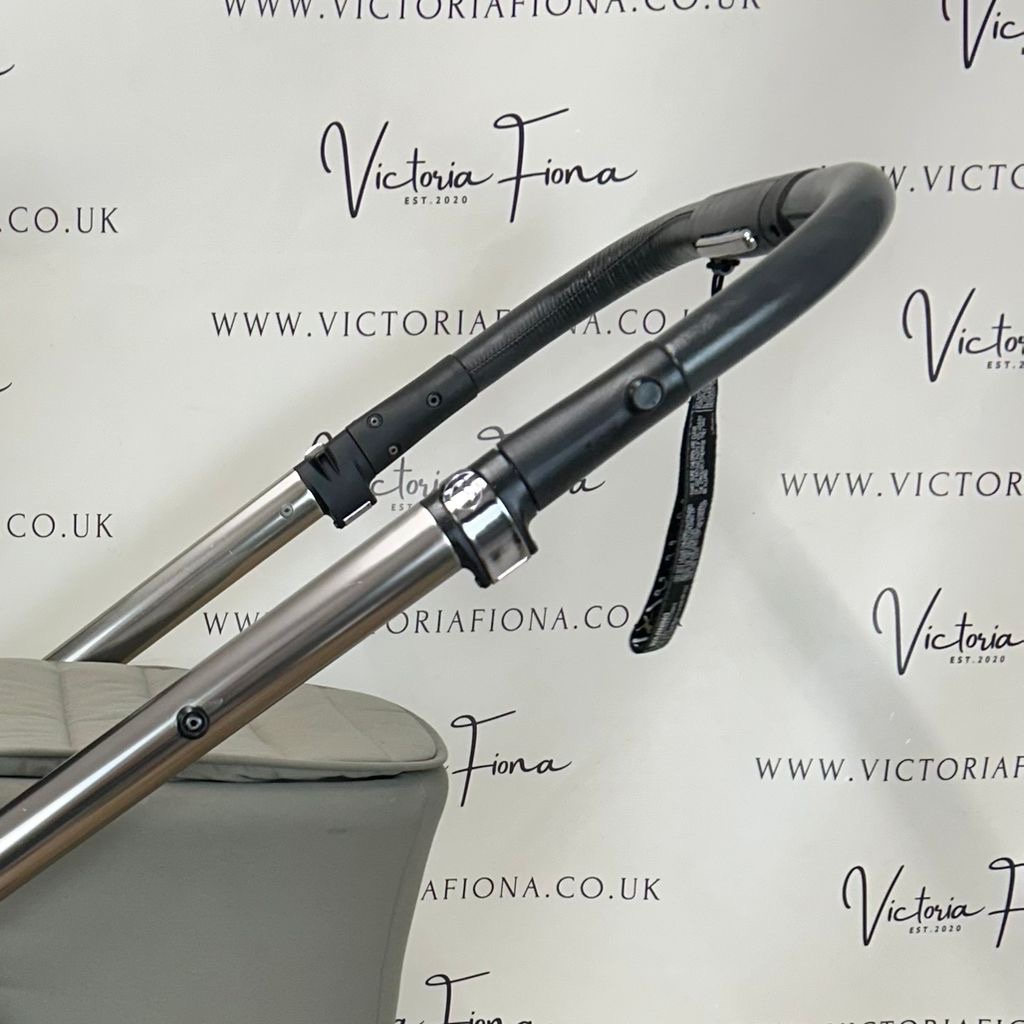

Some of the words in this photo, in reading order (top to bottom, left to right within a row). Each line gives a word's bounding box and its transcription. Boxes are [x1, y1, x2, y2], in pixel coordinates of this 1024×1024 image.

[319, 120, 495, 219] Victoria
[492, 107, 639, 224] Fiona
[404, 195, 468, 206] EST.2020
[872, 586, 1024, 676] Victoria
[949, 655, 1006, 665] EST.2020
[449, 709, 573, 808] Fiona
[420, 875, 662, 902] AFIONA.CO.UK
[841, 863, 986, 947] Victoria
[908, 924, 963, 935] EST.2020
